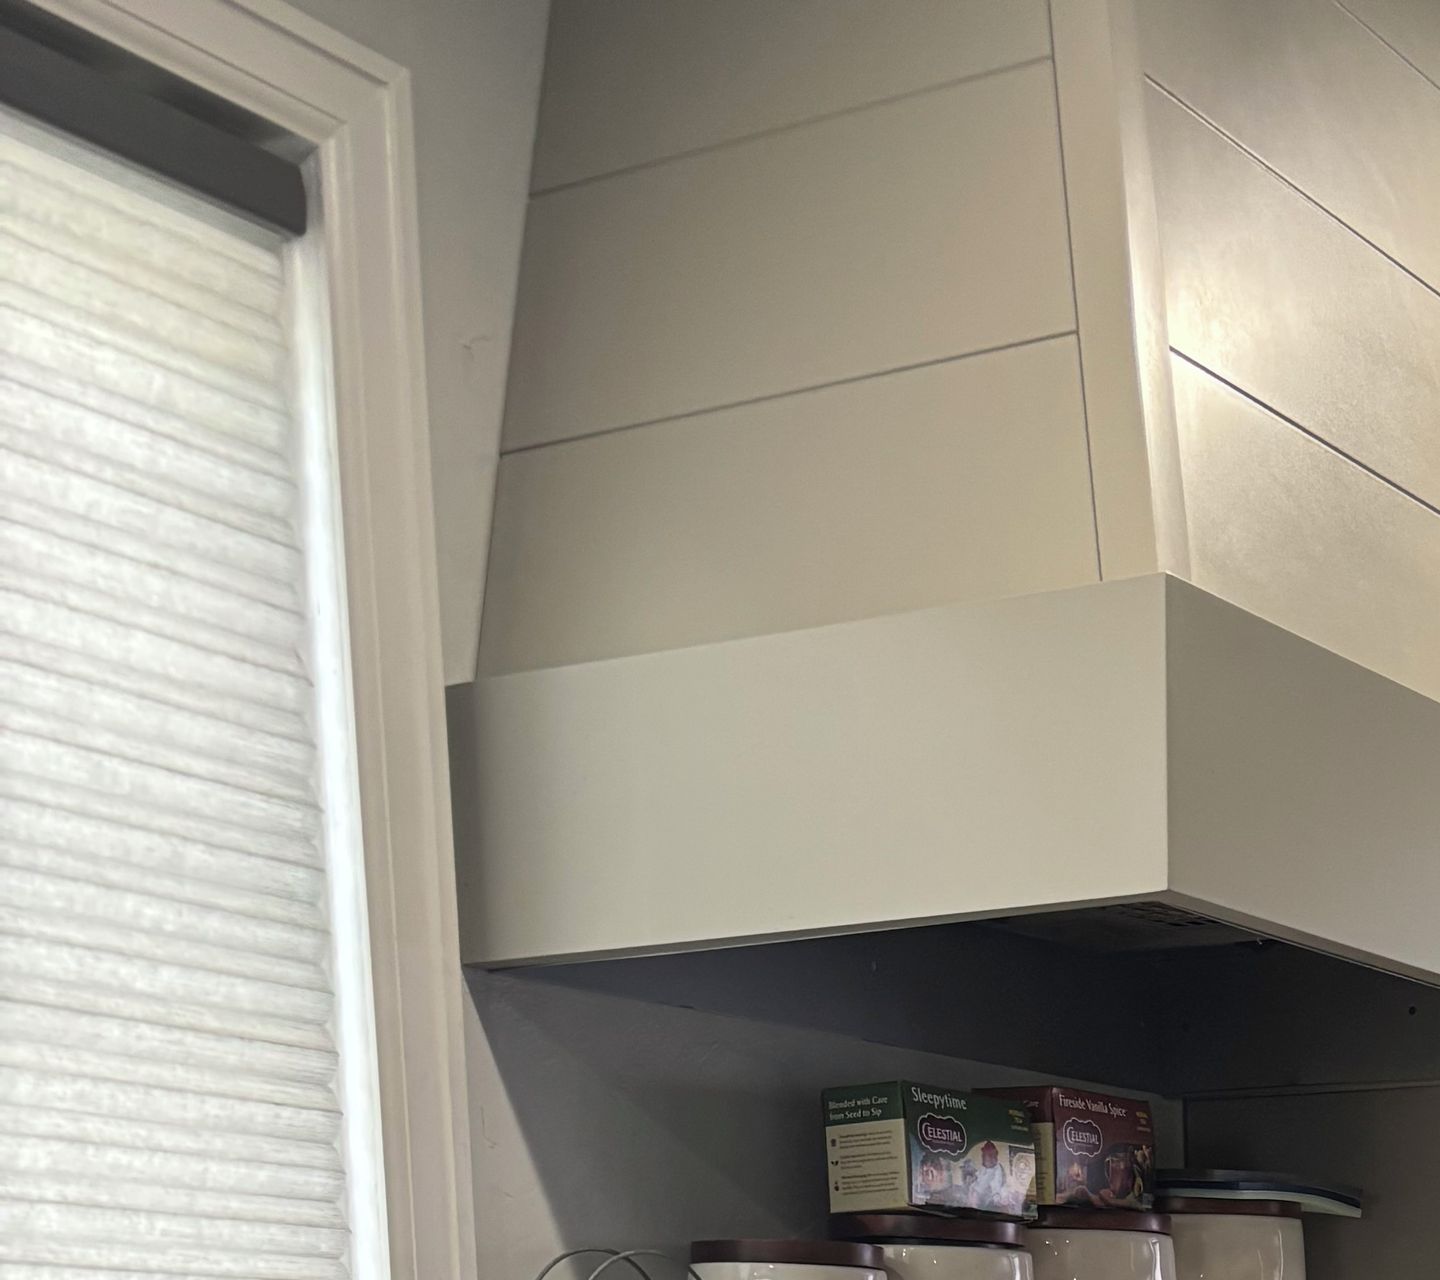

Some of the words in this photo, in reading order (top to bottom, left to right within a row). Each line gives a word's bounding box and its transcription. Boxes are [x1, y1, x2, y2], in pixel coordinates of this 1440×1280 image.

[911, 1086, 967, 1110] Sleepytime
[1059, 1094, 1086, 1110] Fireside
[1086, 1099, 1108, 1114] Vanilla
[1108, 1102, 1127, 1118] Spice
[922, 1122, 963, 1142] CELESTIAL
[1066, 1126, 1099, 1145] CELESTIAL
